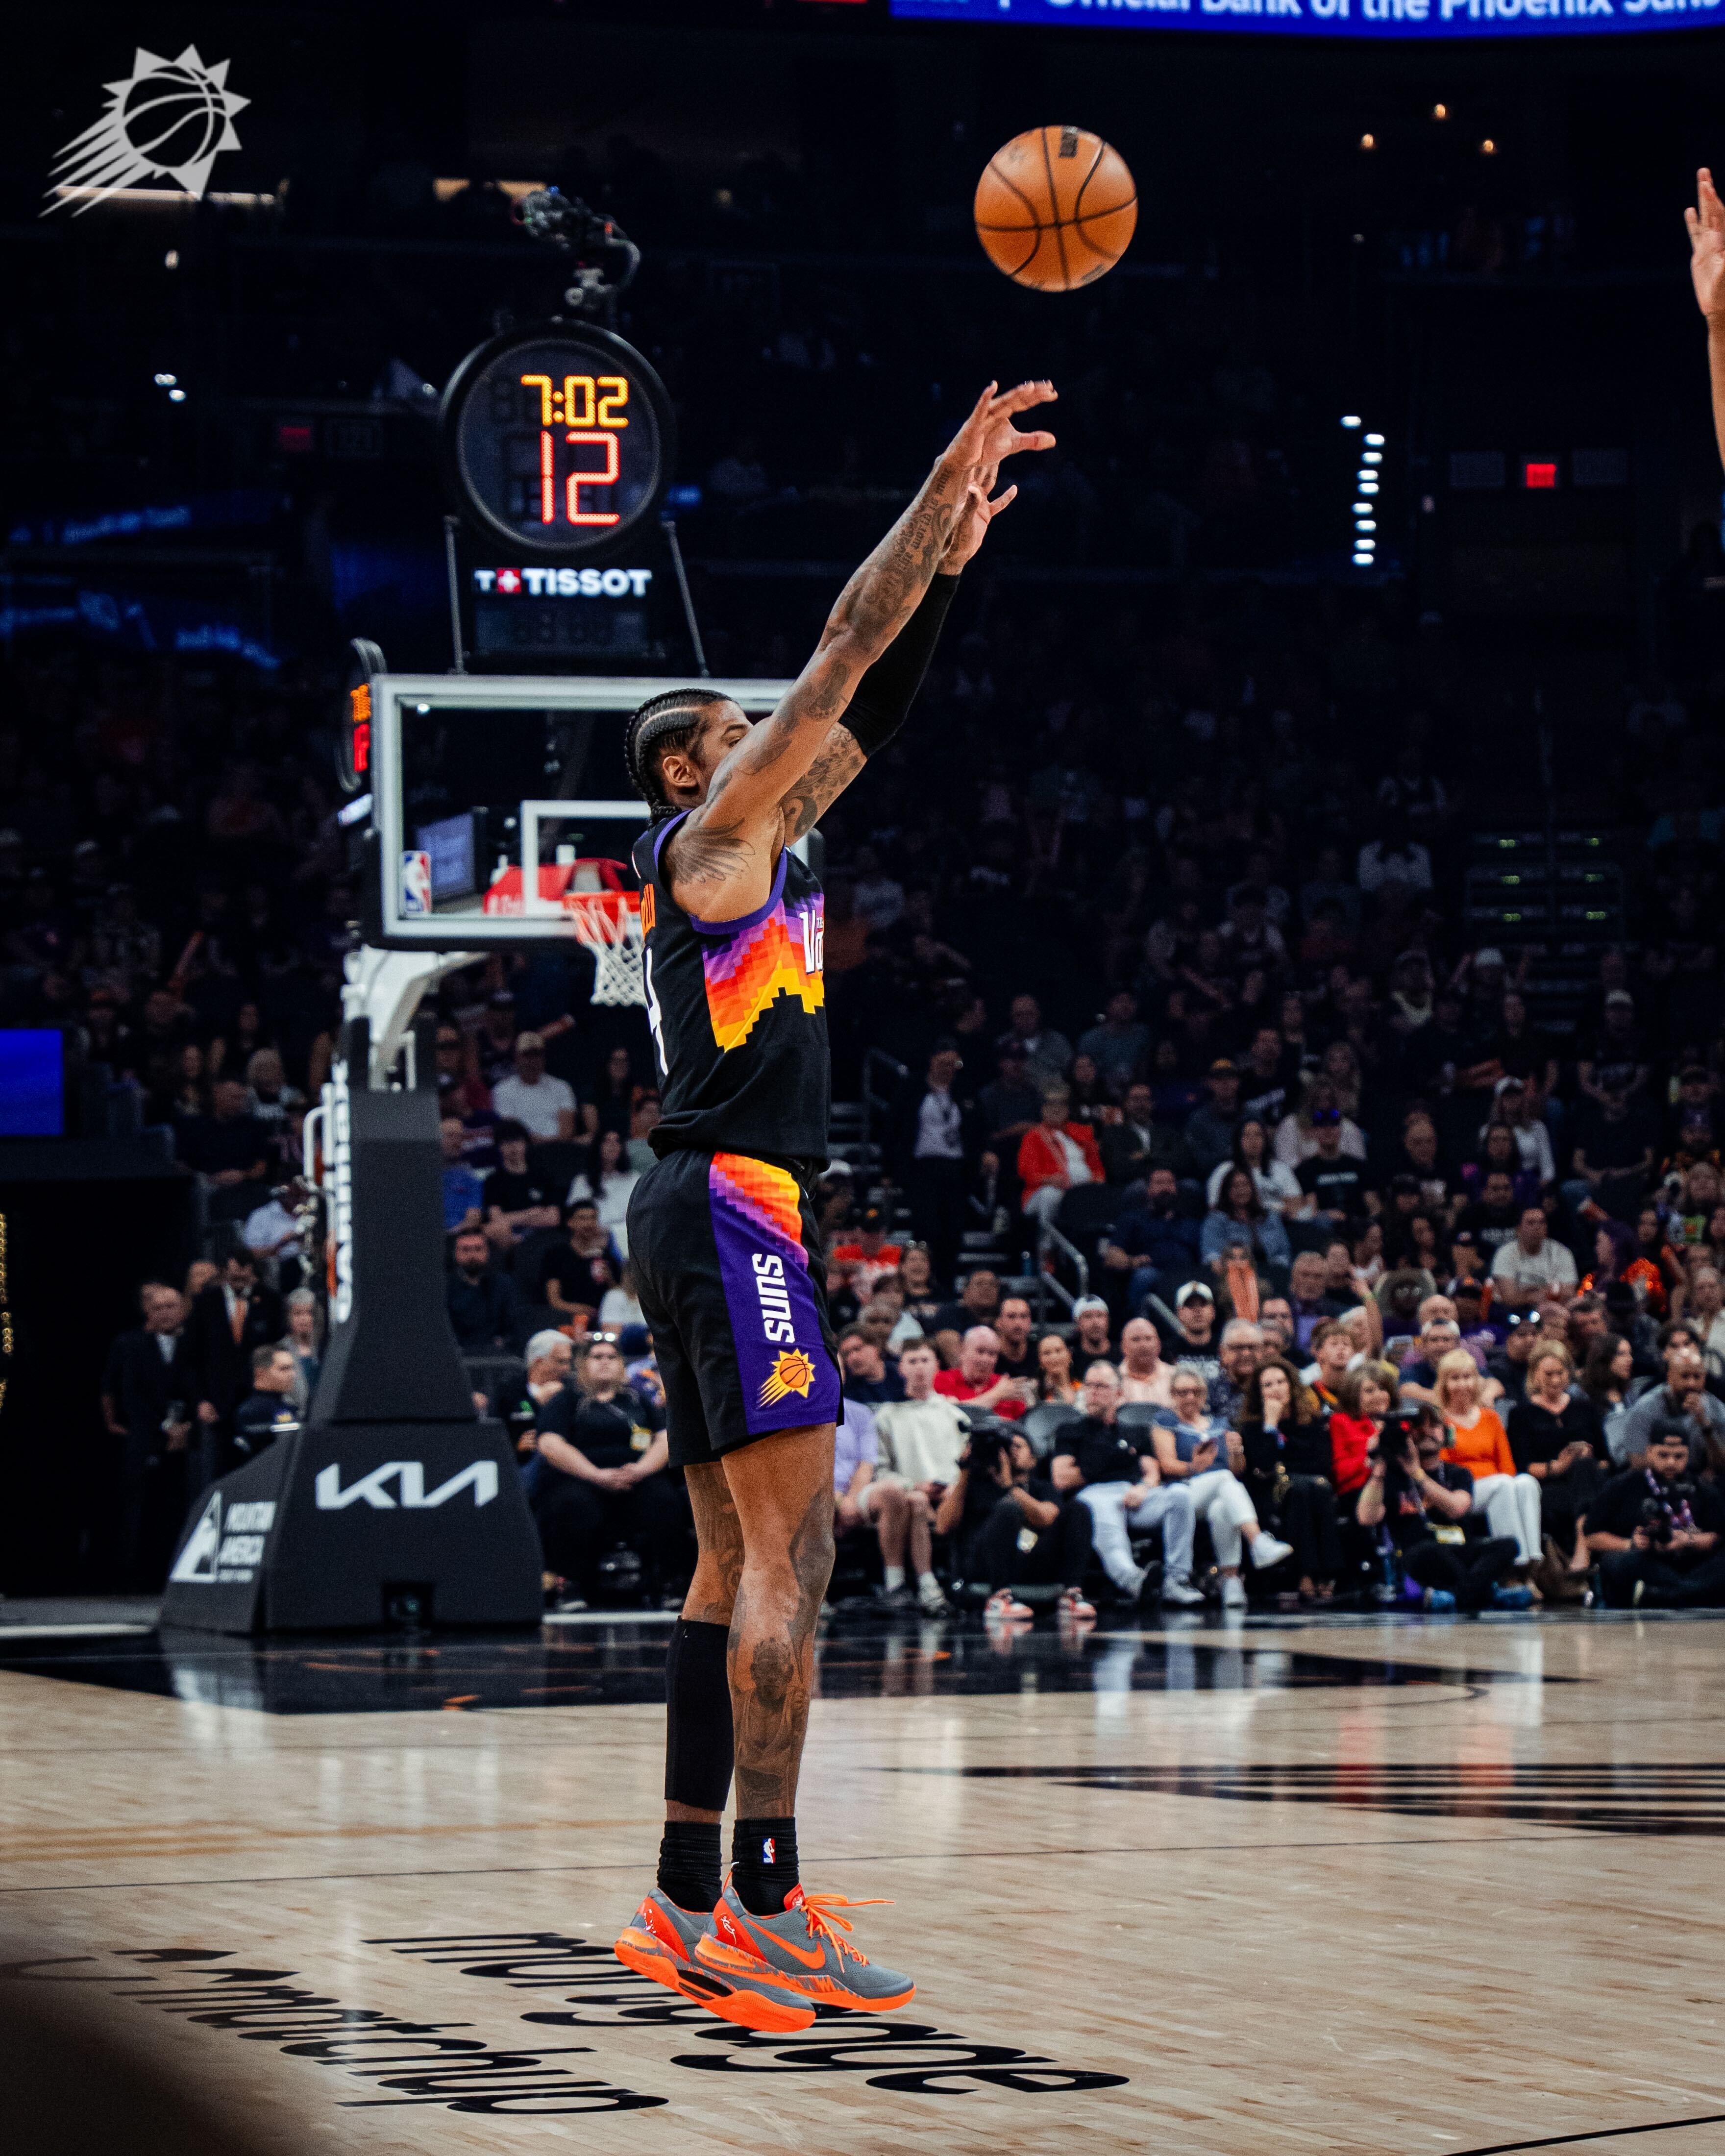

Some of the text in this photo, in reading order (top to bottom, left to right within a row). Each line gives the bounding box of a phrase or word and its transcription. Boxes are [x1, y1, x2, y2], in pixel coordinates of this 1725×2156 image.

[521, 374, 629, 427] 7:02
[541, 430, 620, 526] 12
[521, 568, 653, 596] TISSOT
[752, 1253, 796, 1344] SUNS
[315, 1460, 498, 1510] KIA
[110, 1984, 669, 2115] matchup
